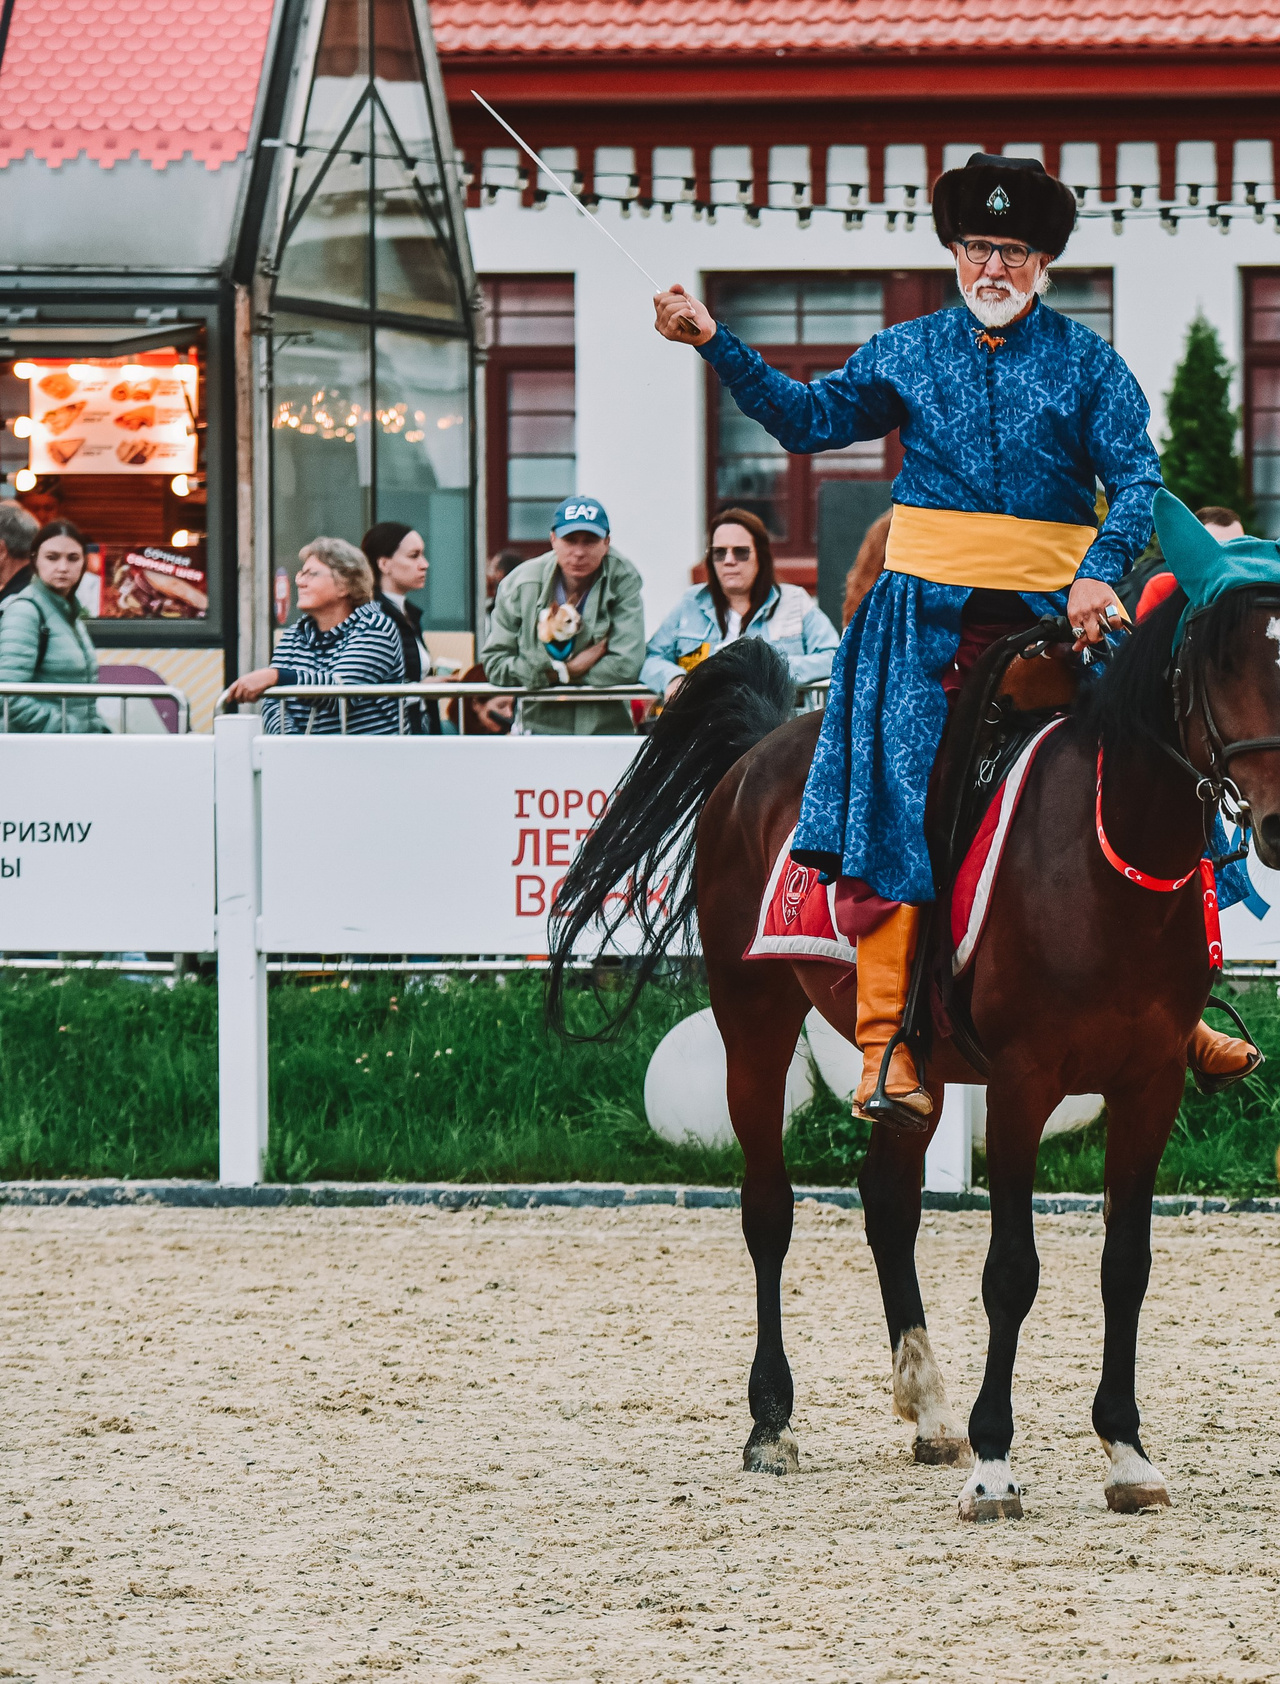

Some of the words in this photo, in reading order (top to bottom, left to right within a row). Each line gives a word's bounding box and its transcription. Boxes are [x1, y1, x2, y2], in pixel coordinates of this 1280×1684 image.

[564, 504, 599, 521] EA7
[514, 789, 622, 819] ГОРО
[0, 821, 92, 843] РИЗМУ
